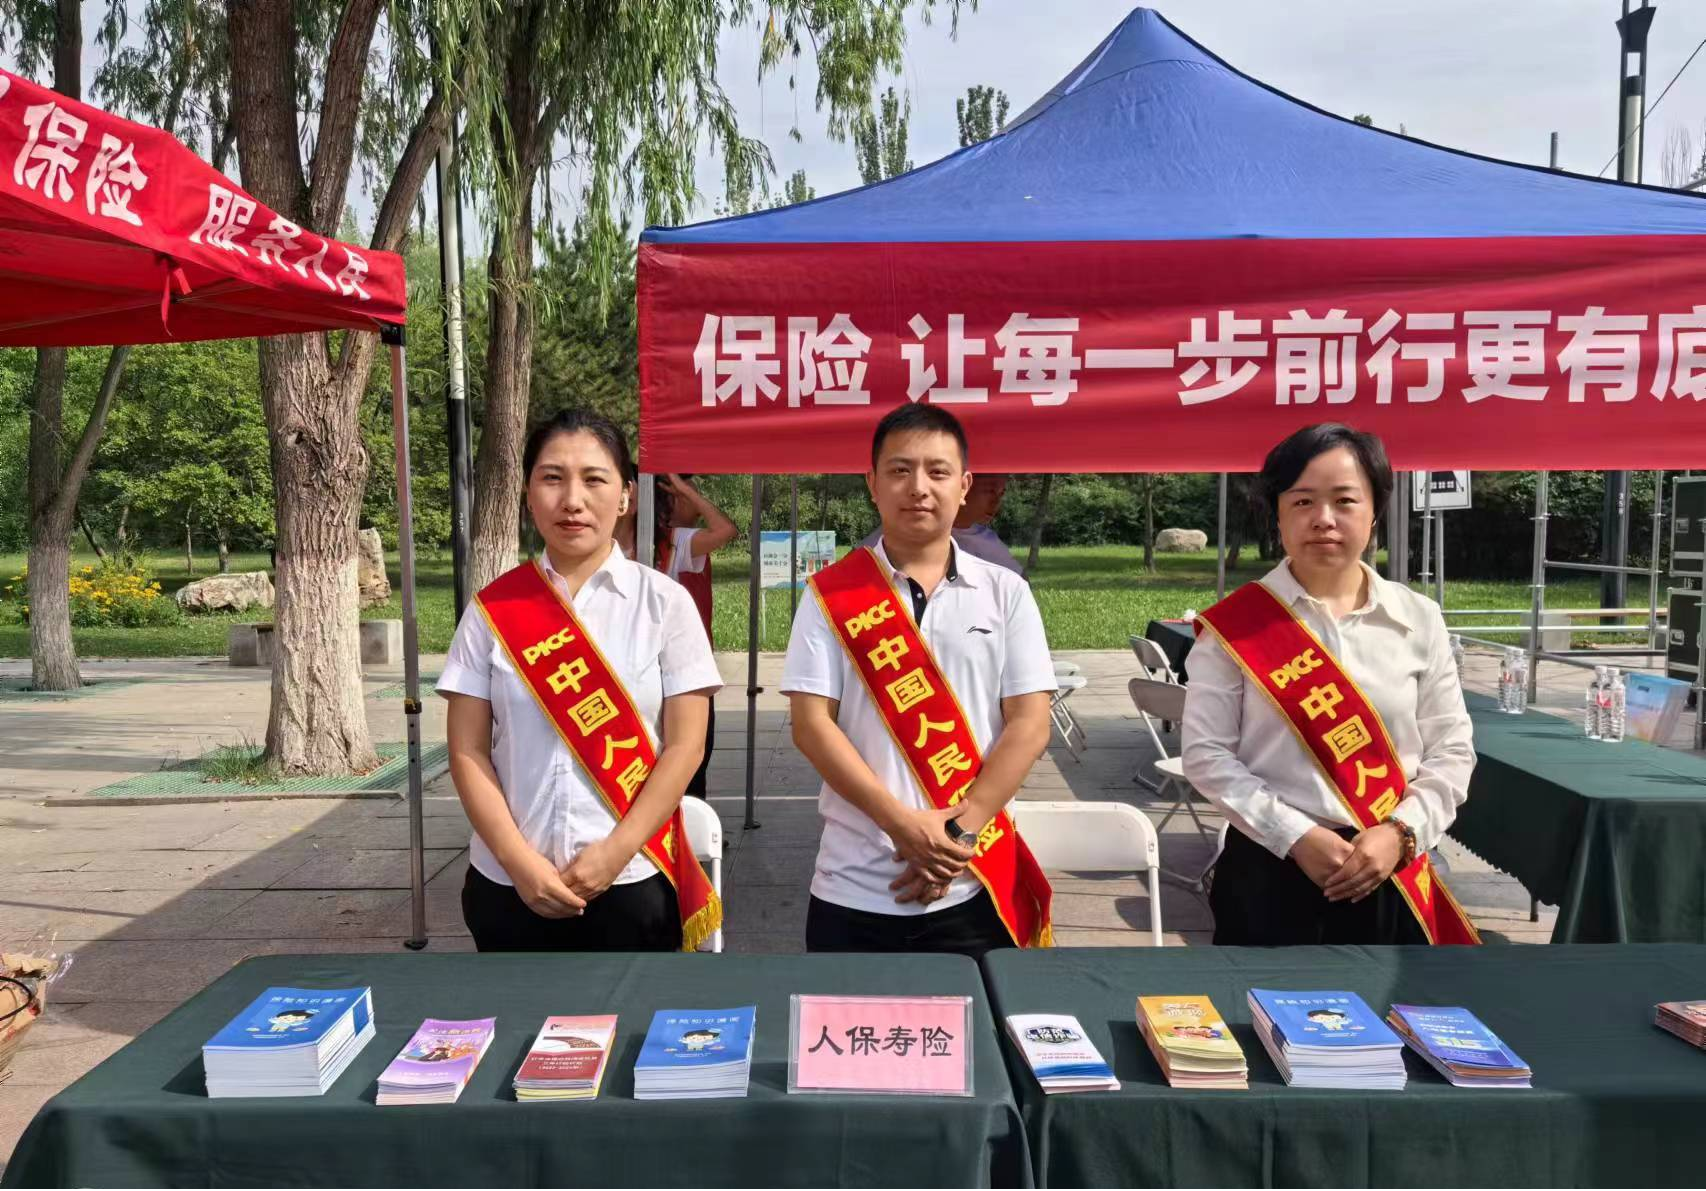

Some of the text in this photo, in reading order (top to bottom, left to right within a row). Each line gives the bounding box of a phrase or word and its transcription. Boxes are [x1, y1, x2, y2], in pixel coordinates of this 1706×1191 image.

[0, 75, 371, 300] 保险 服务人民
[692, 304, 1706, 408] 保险 让每一步前行更有底
[844, 599, 896, 640] PICC
[522, 627, 576, 665] PICC
[1269, 647, 1324, 690] PICC
[808, 1025, 954, 1057] 人保寿险
